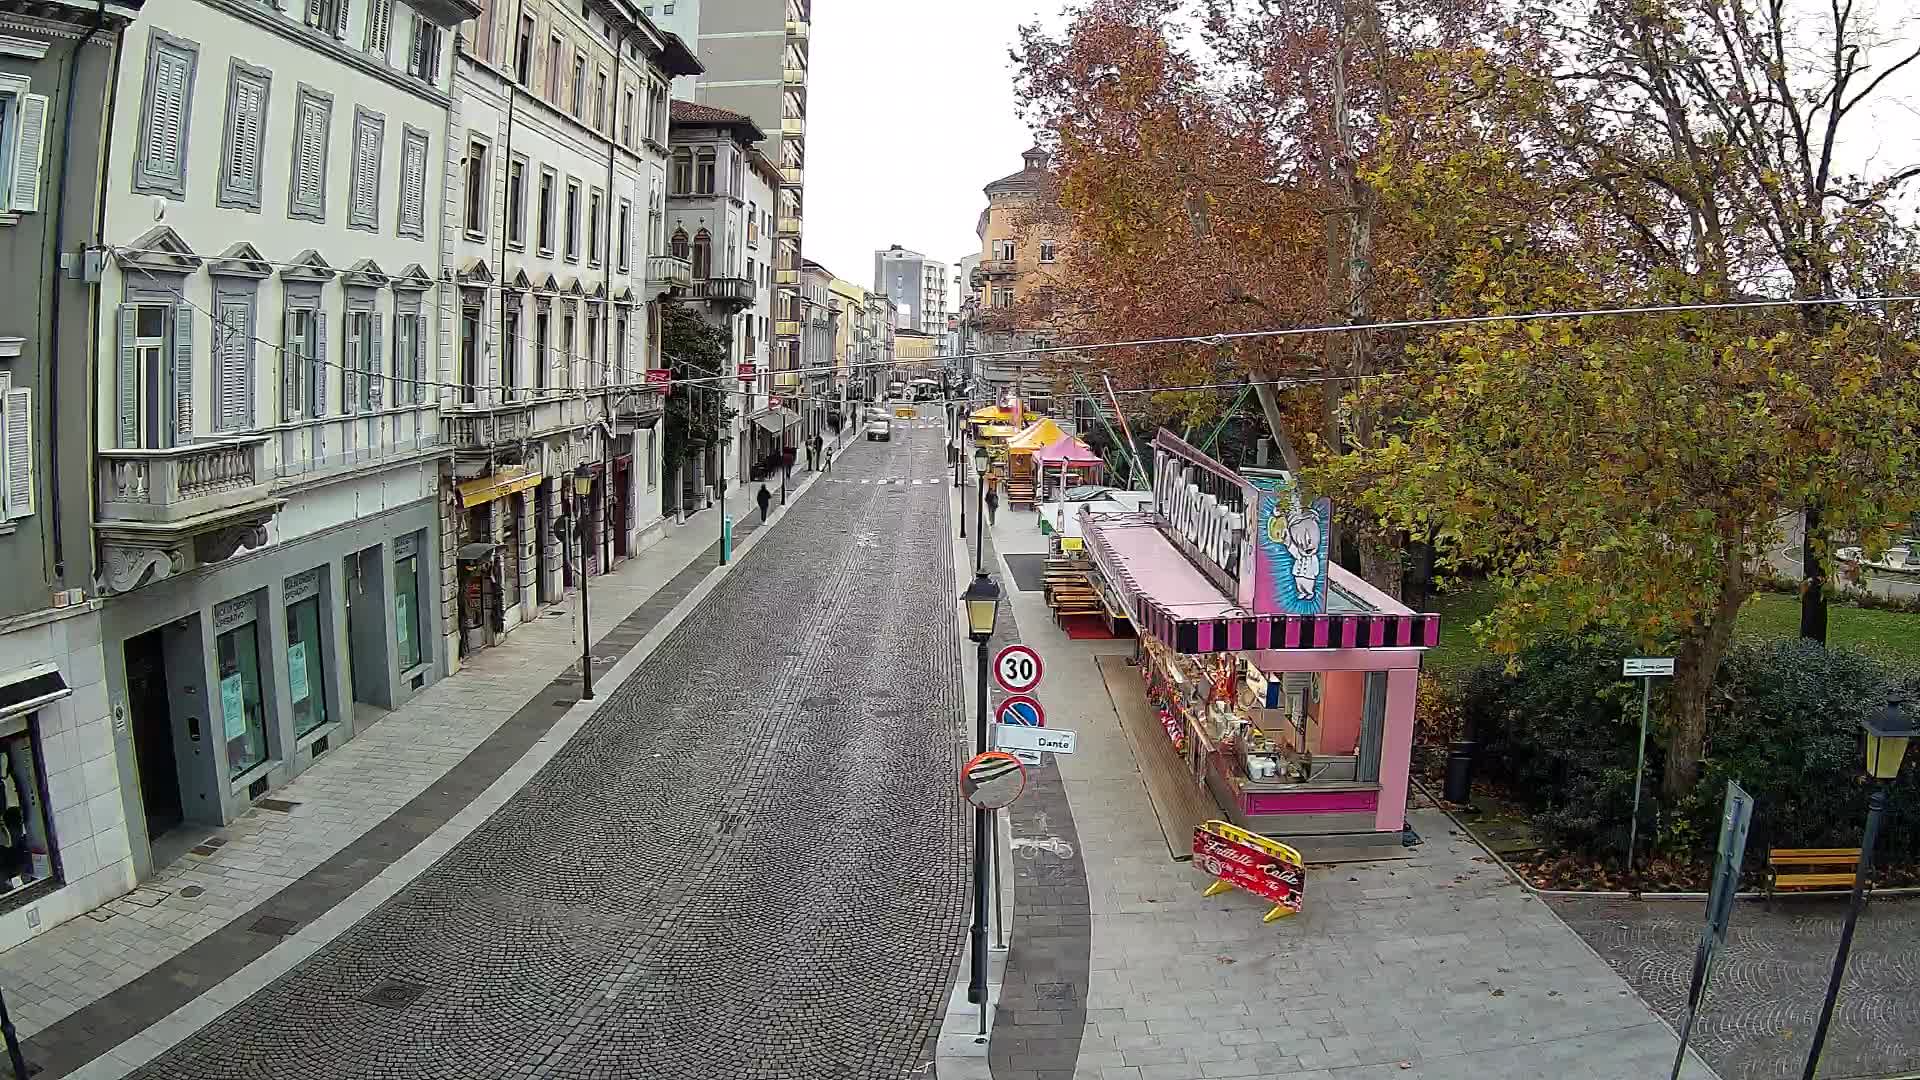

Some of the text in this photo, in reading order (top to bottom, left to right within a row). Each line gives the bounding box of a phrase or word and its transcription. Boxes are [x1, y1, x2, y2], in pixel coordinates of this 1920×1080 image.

[1005, 658, 1033, 681] 30
[1038, 737, 1069, 749] Dante
[1204, 839, 1255, 867] Frittelle
[1256, 863, 1299, 885] Calde
